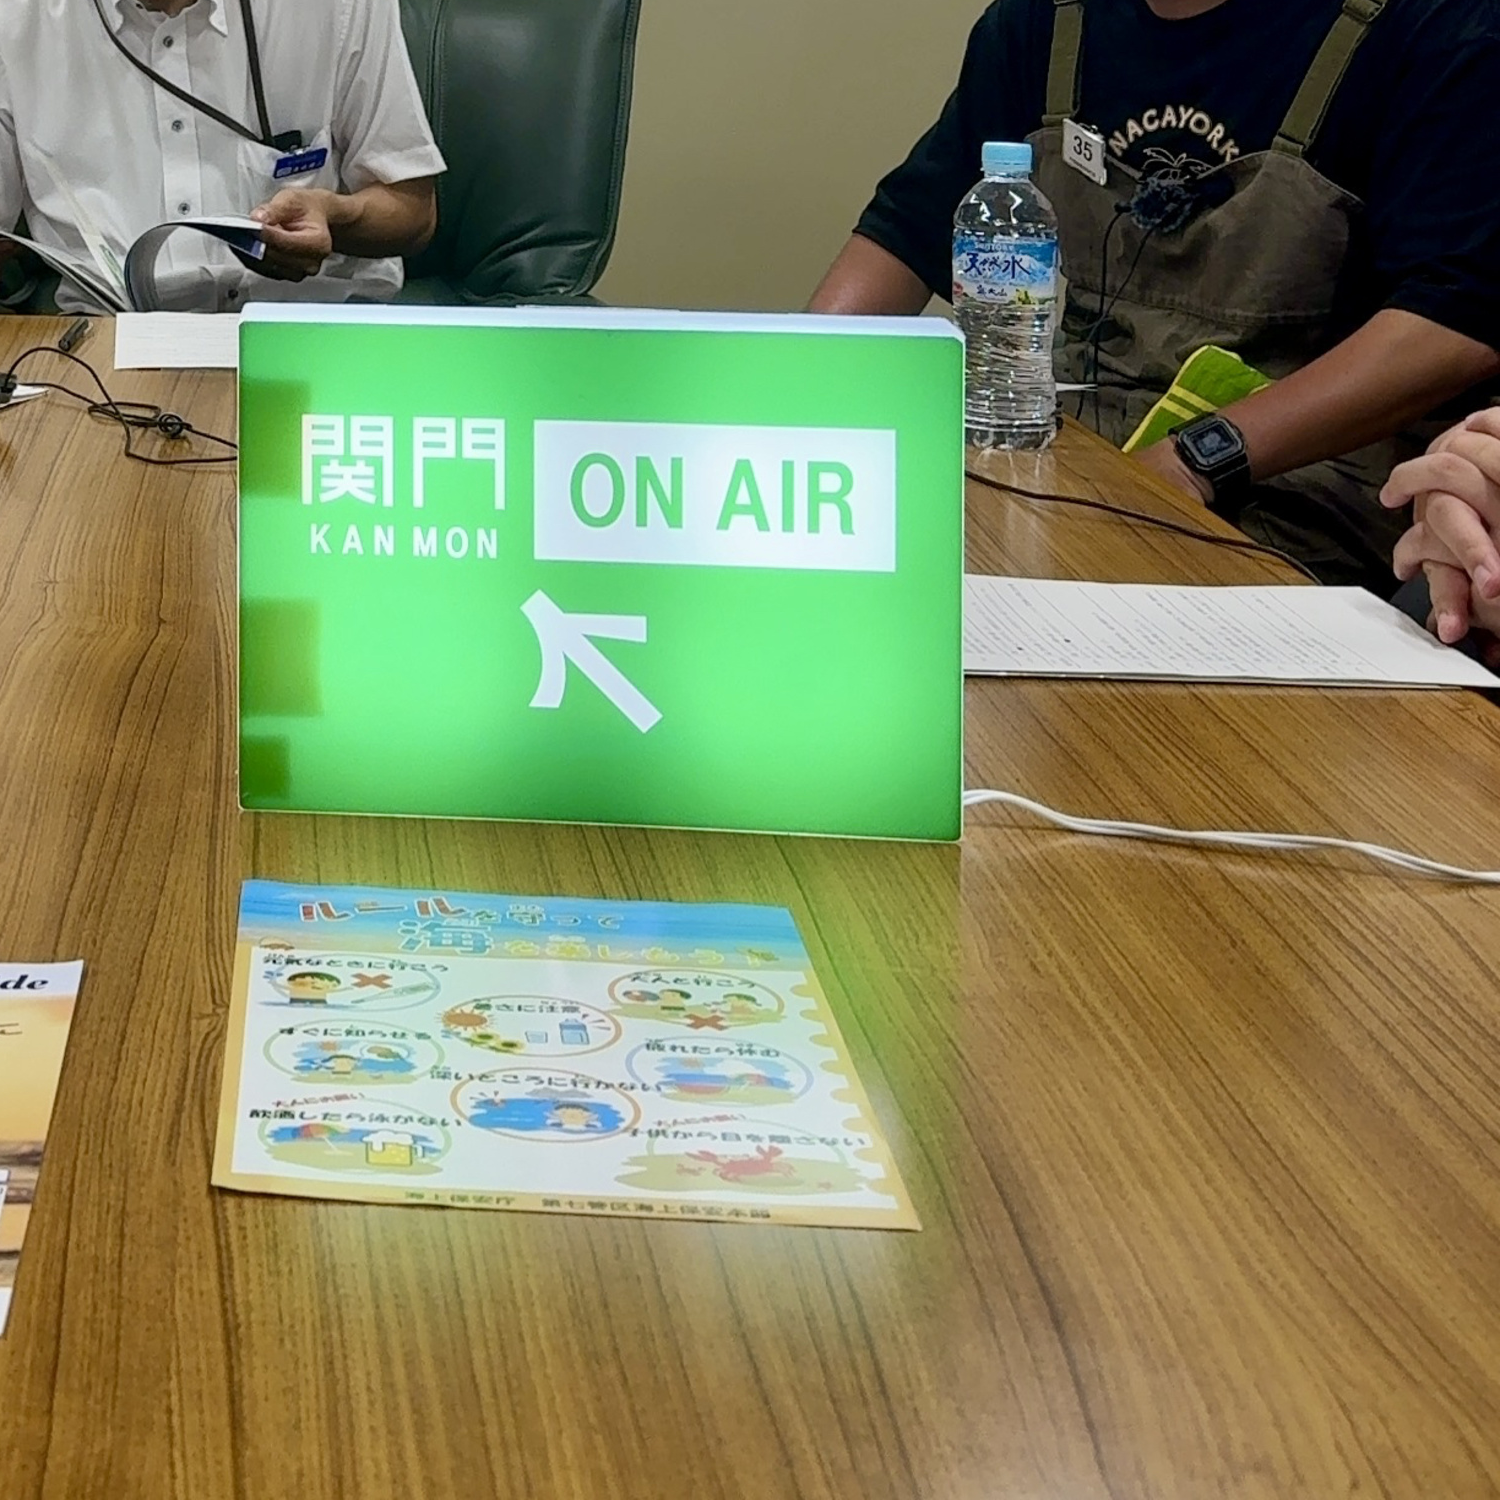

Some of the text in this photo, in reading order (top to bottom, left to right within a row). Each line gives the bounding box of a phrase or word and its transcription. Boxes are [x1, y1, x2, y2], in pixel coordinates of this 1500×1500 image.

[1073, 135, 1093, 162] 35
[963, 252, 1031, 279] 天然水
[301, 414, 506, 511] 関門
[569, 452, 857, 536] ON AIR
[310, 524, 498, 559] KAN MON
